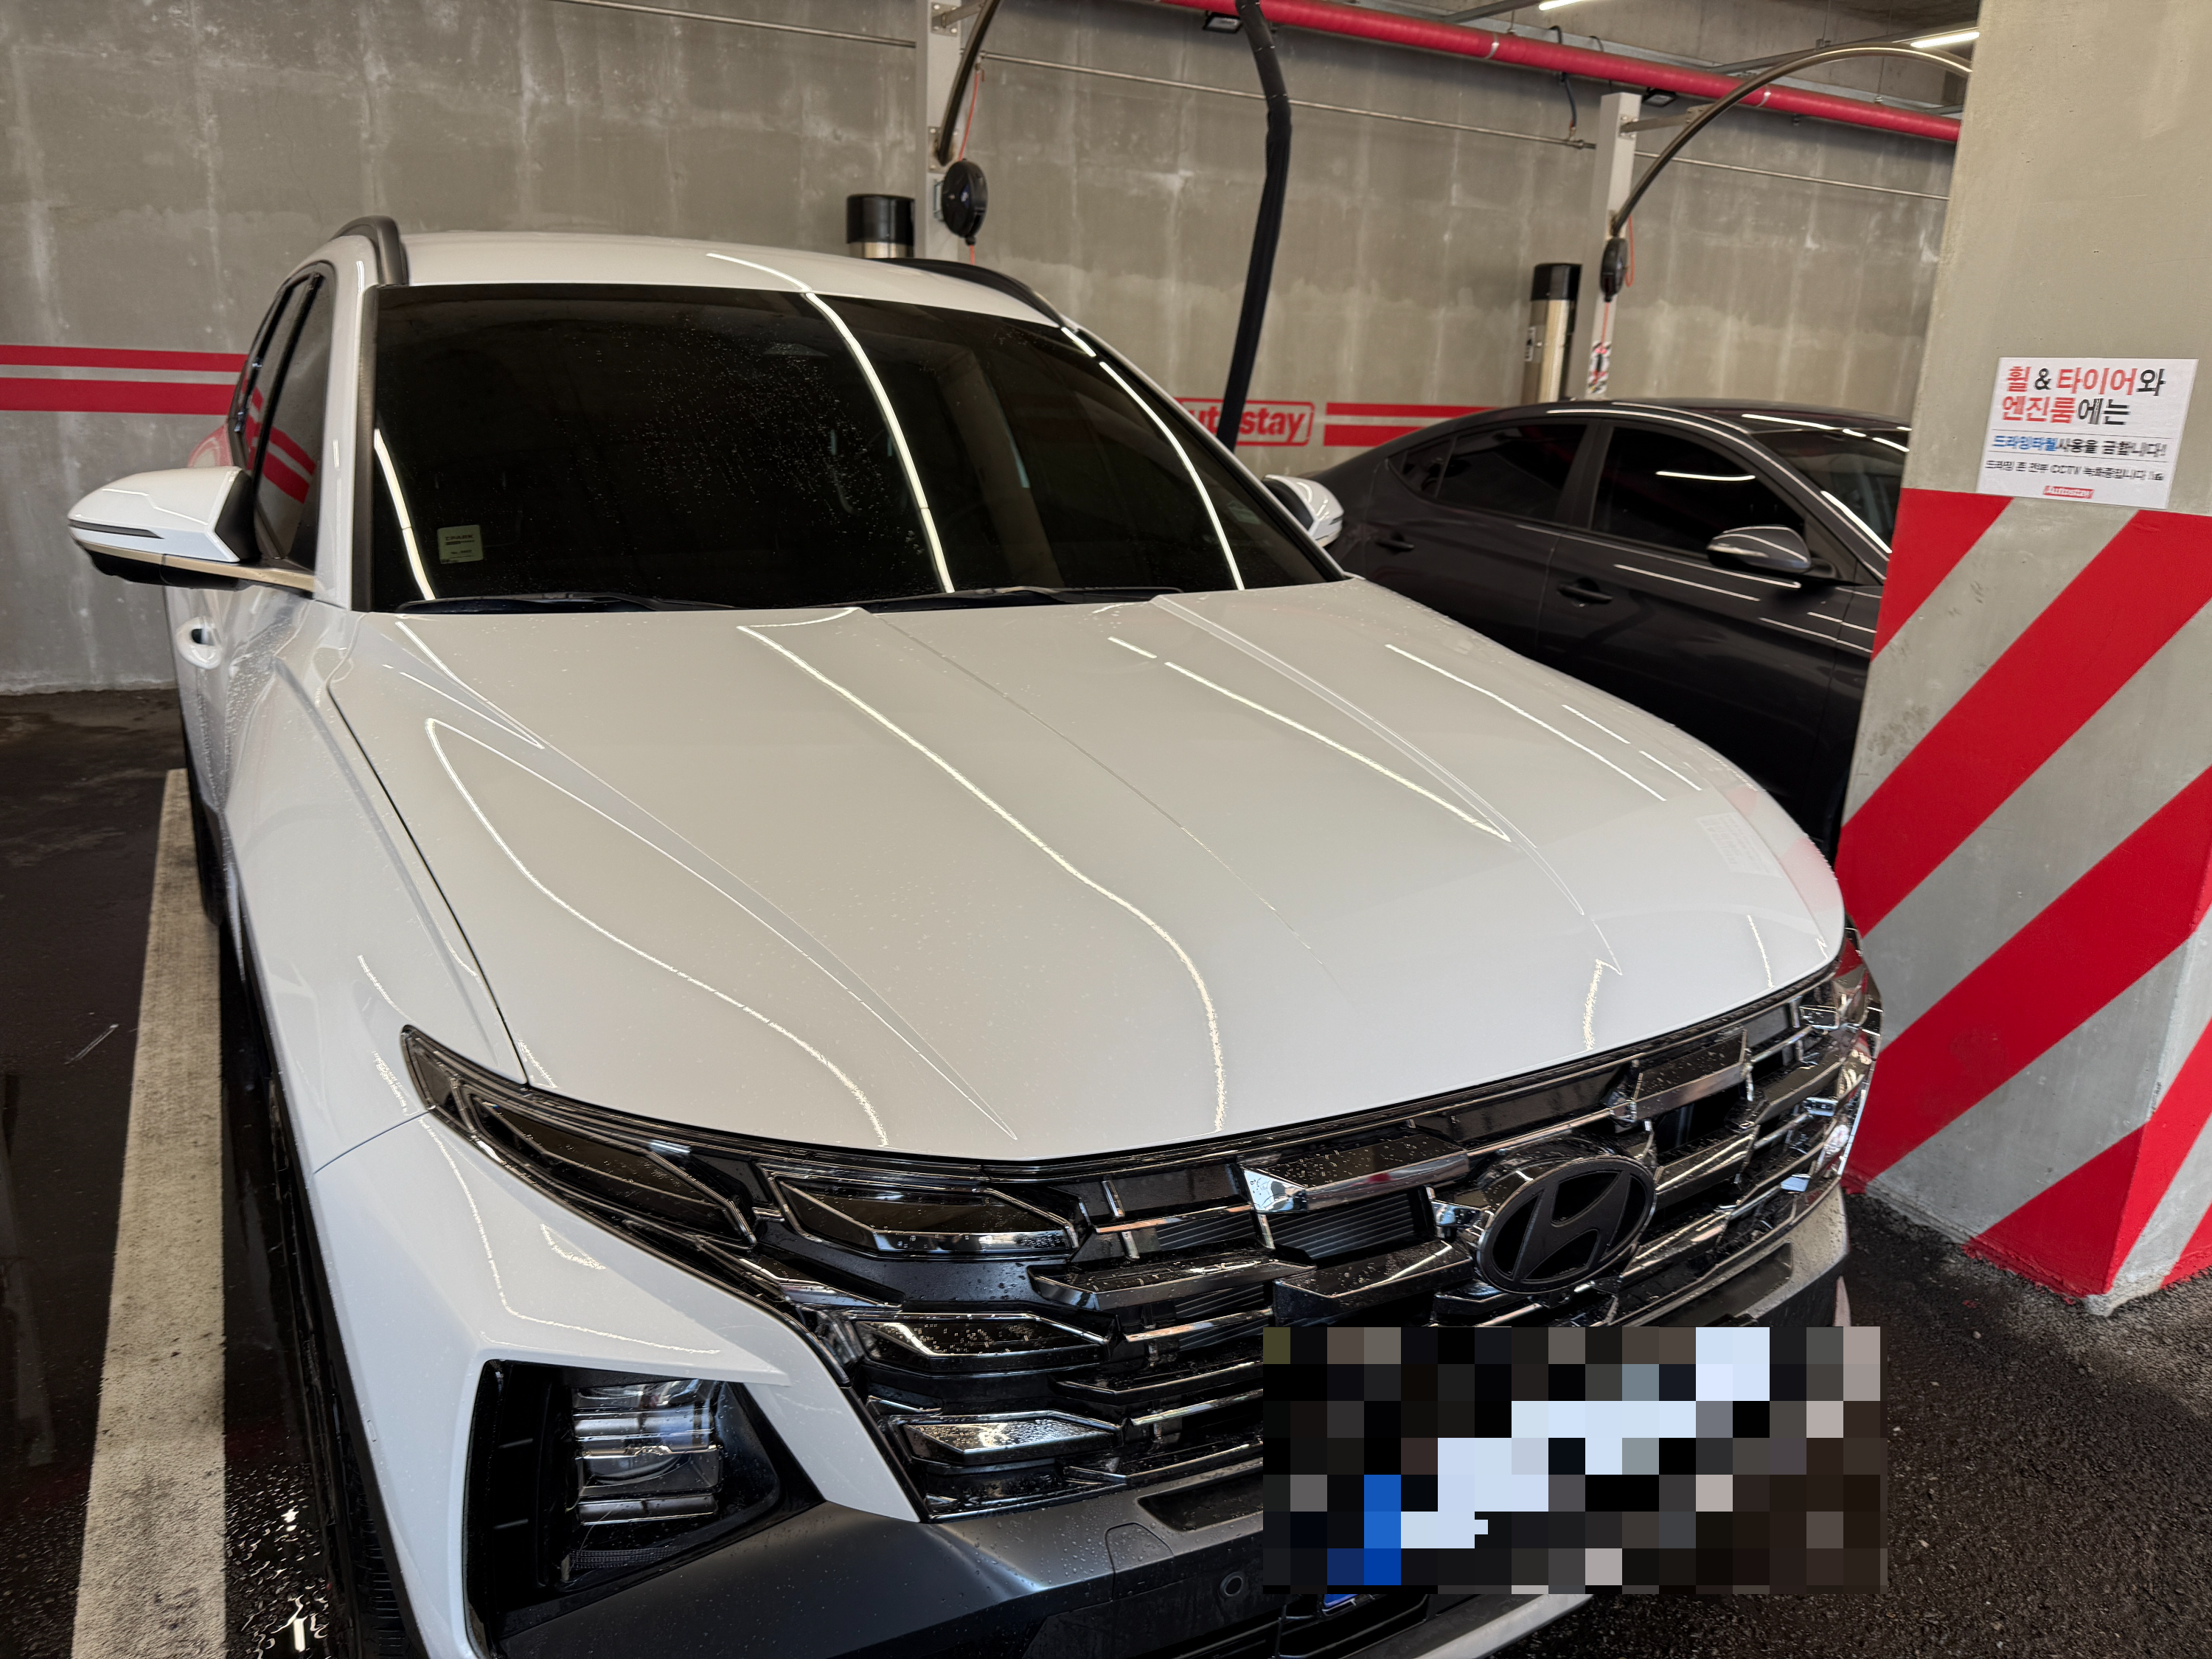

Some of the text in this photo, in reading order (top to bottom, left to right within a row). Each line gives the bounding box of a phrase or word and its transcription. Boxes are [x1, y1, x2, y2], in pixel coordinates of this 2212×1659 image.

[2006, 366, 2166, 396] 휠 & 타이어와
[2002, 395, 2131, 425] 엔진룸에는
[2051, 465, 2082, 474] CCTV
